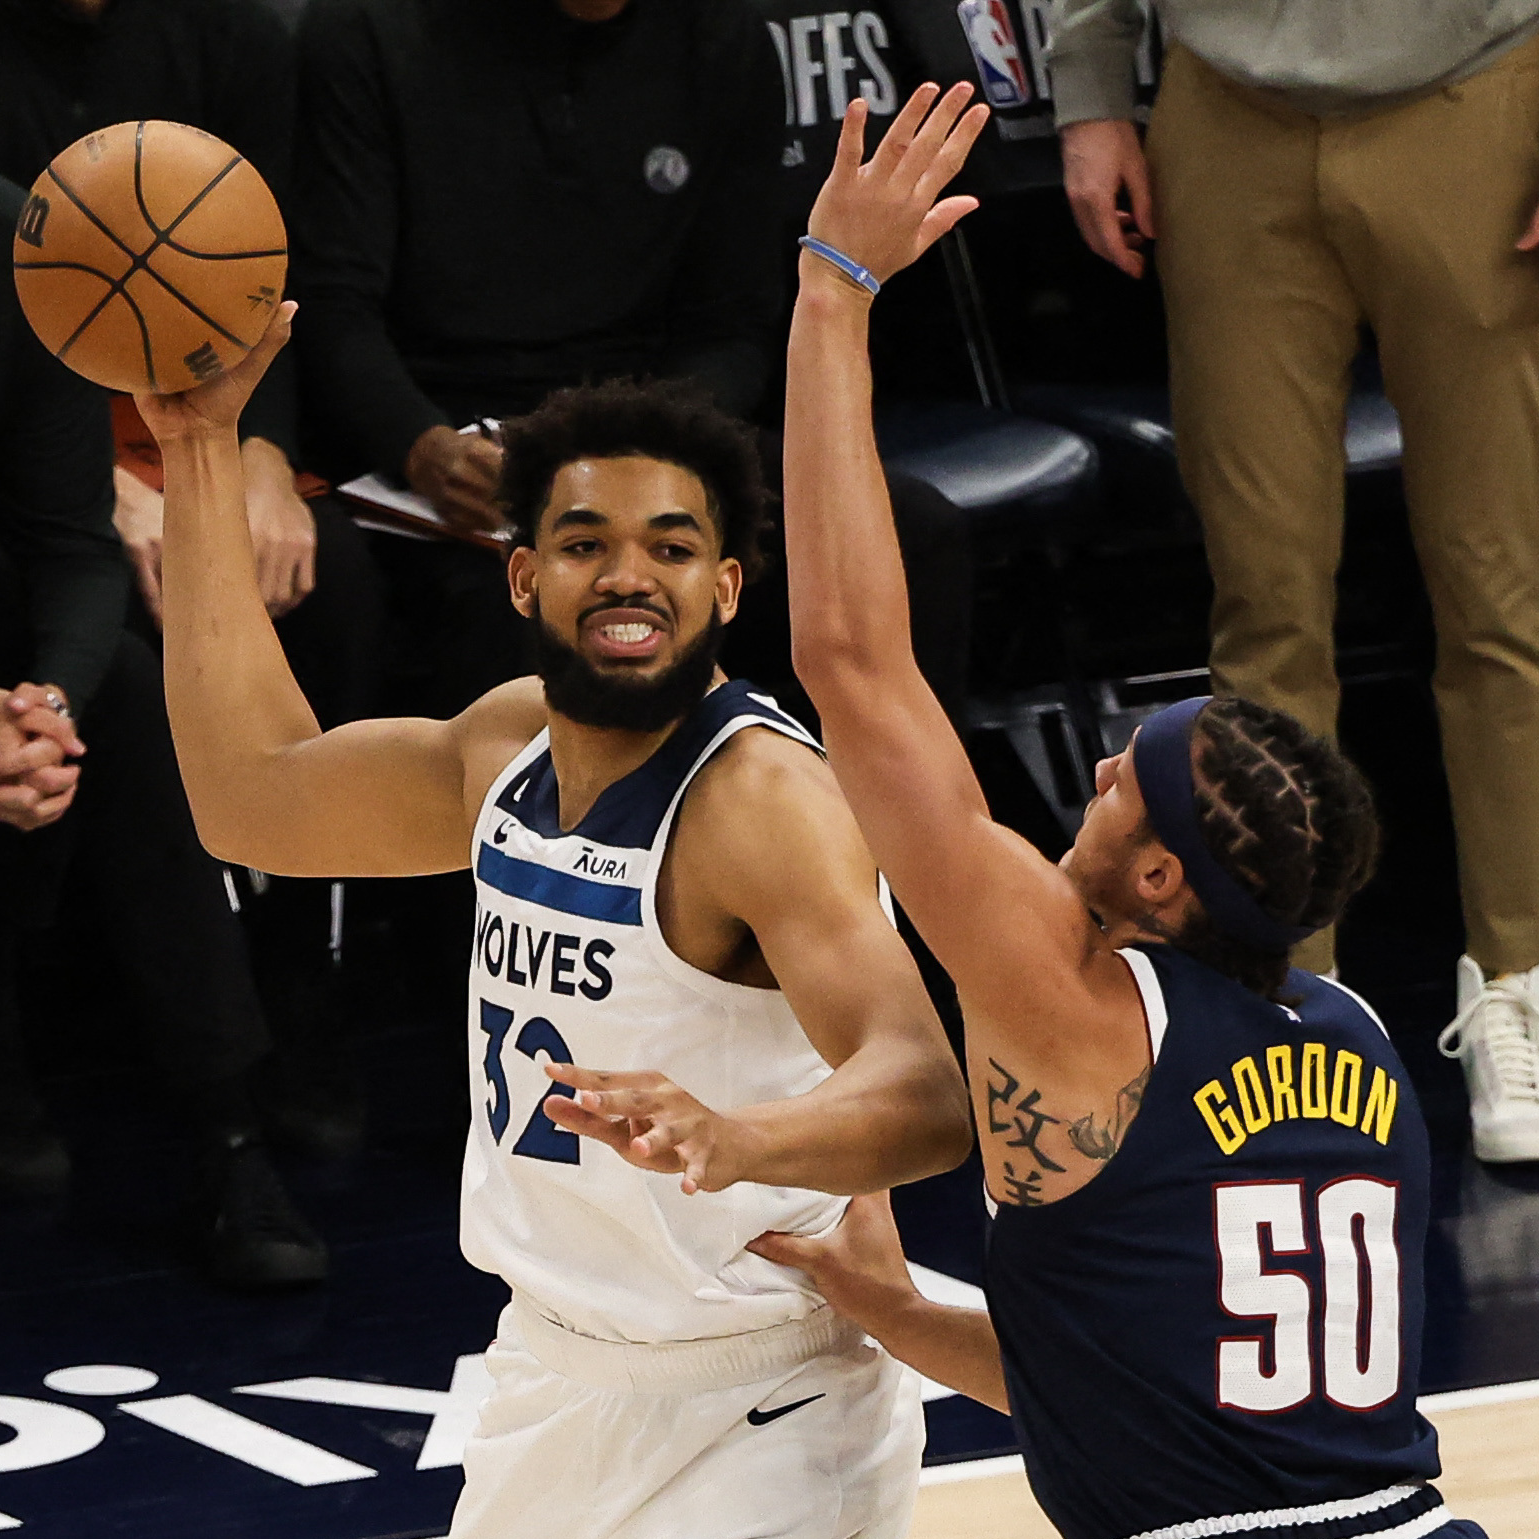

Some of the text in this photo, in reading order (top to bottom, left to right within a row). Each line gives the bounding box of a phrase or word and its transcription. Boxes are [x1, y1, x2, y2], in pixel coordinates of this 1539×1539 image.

[766, 10, 898, 127] FFS
[479, 997, 580, 1165] 32
[1192, 1042, 1399, 1157] GORDON
[1211, 1173, 1402, 1416] 50
